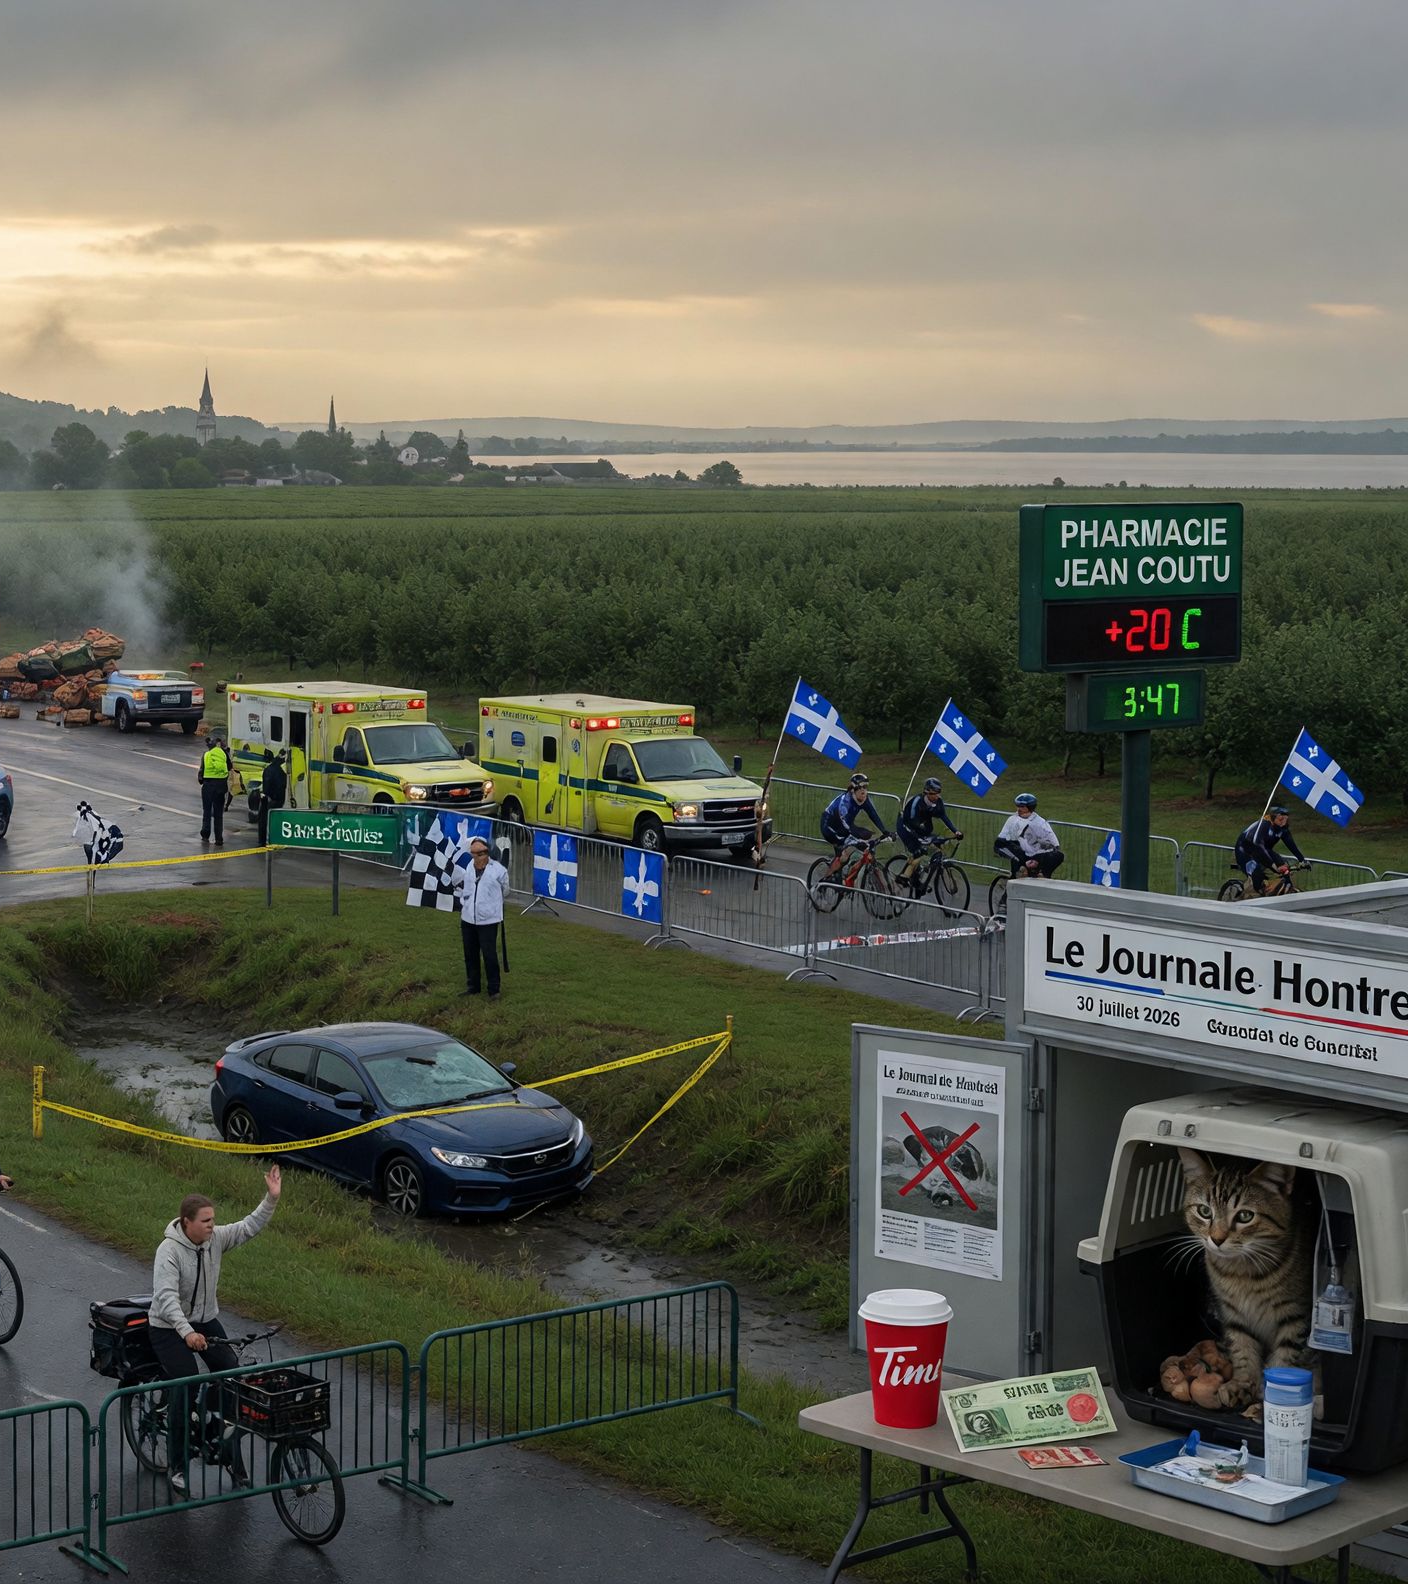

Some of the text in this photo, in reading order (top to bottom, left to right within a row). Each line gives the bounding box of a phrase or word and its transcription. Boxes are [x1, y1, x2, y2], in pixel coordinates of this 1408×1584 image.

[1061, 518, 1227, 548] PHARMACIE
[1055, 555, 1230, 587] JEAN COUTU
[1106, 608, 1171, 652] +20
[1124, 684, 1180, 717] 3:47
[1045, 926, 1084, 967] Le
[1076, 995, 1180, 1027] 30 juillet 2026
[884, 1065, 895, 1079] Le
